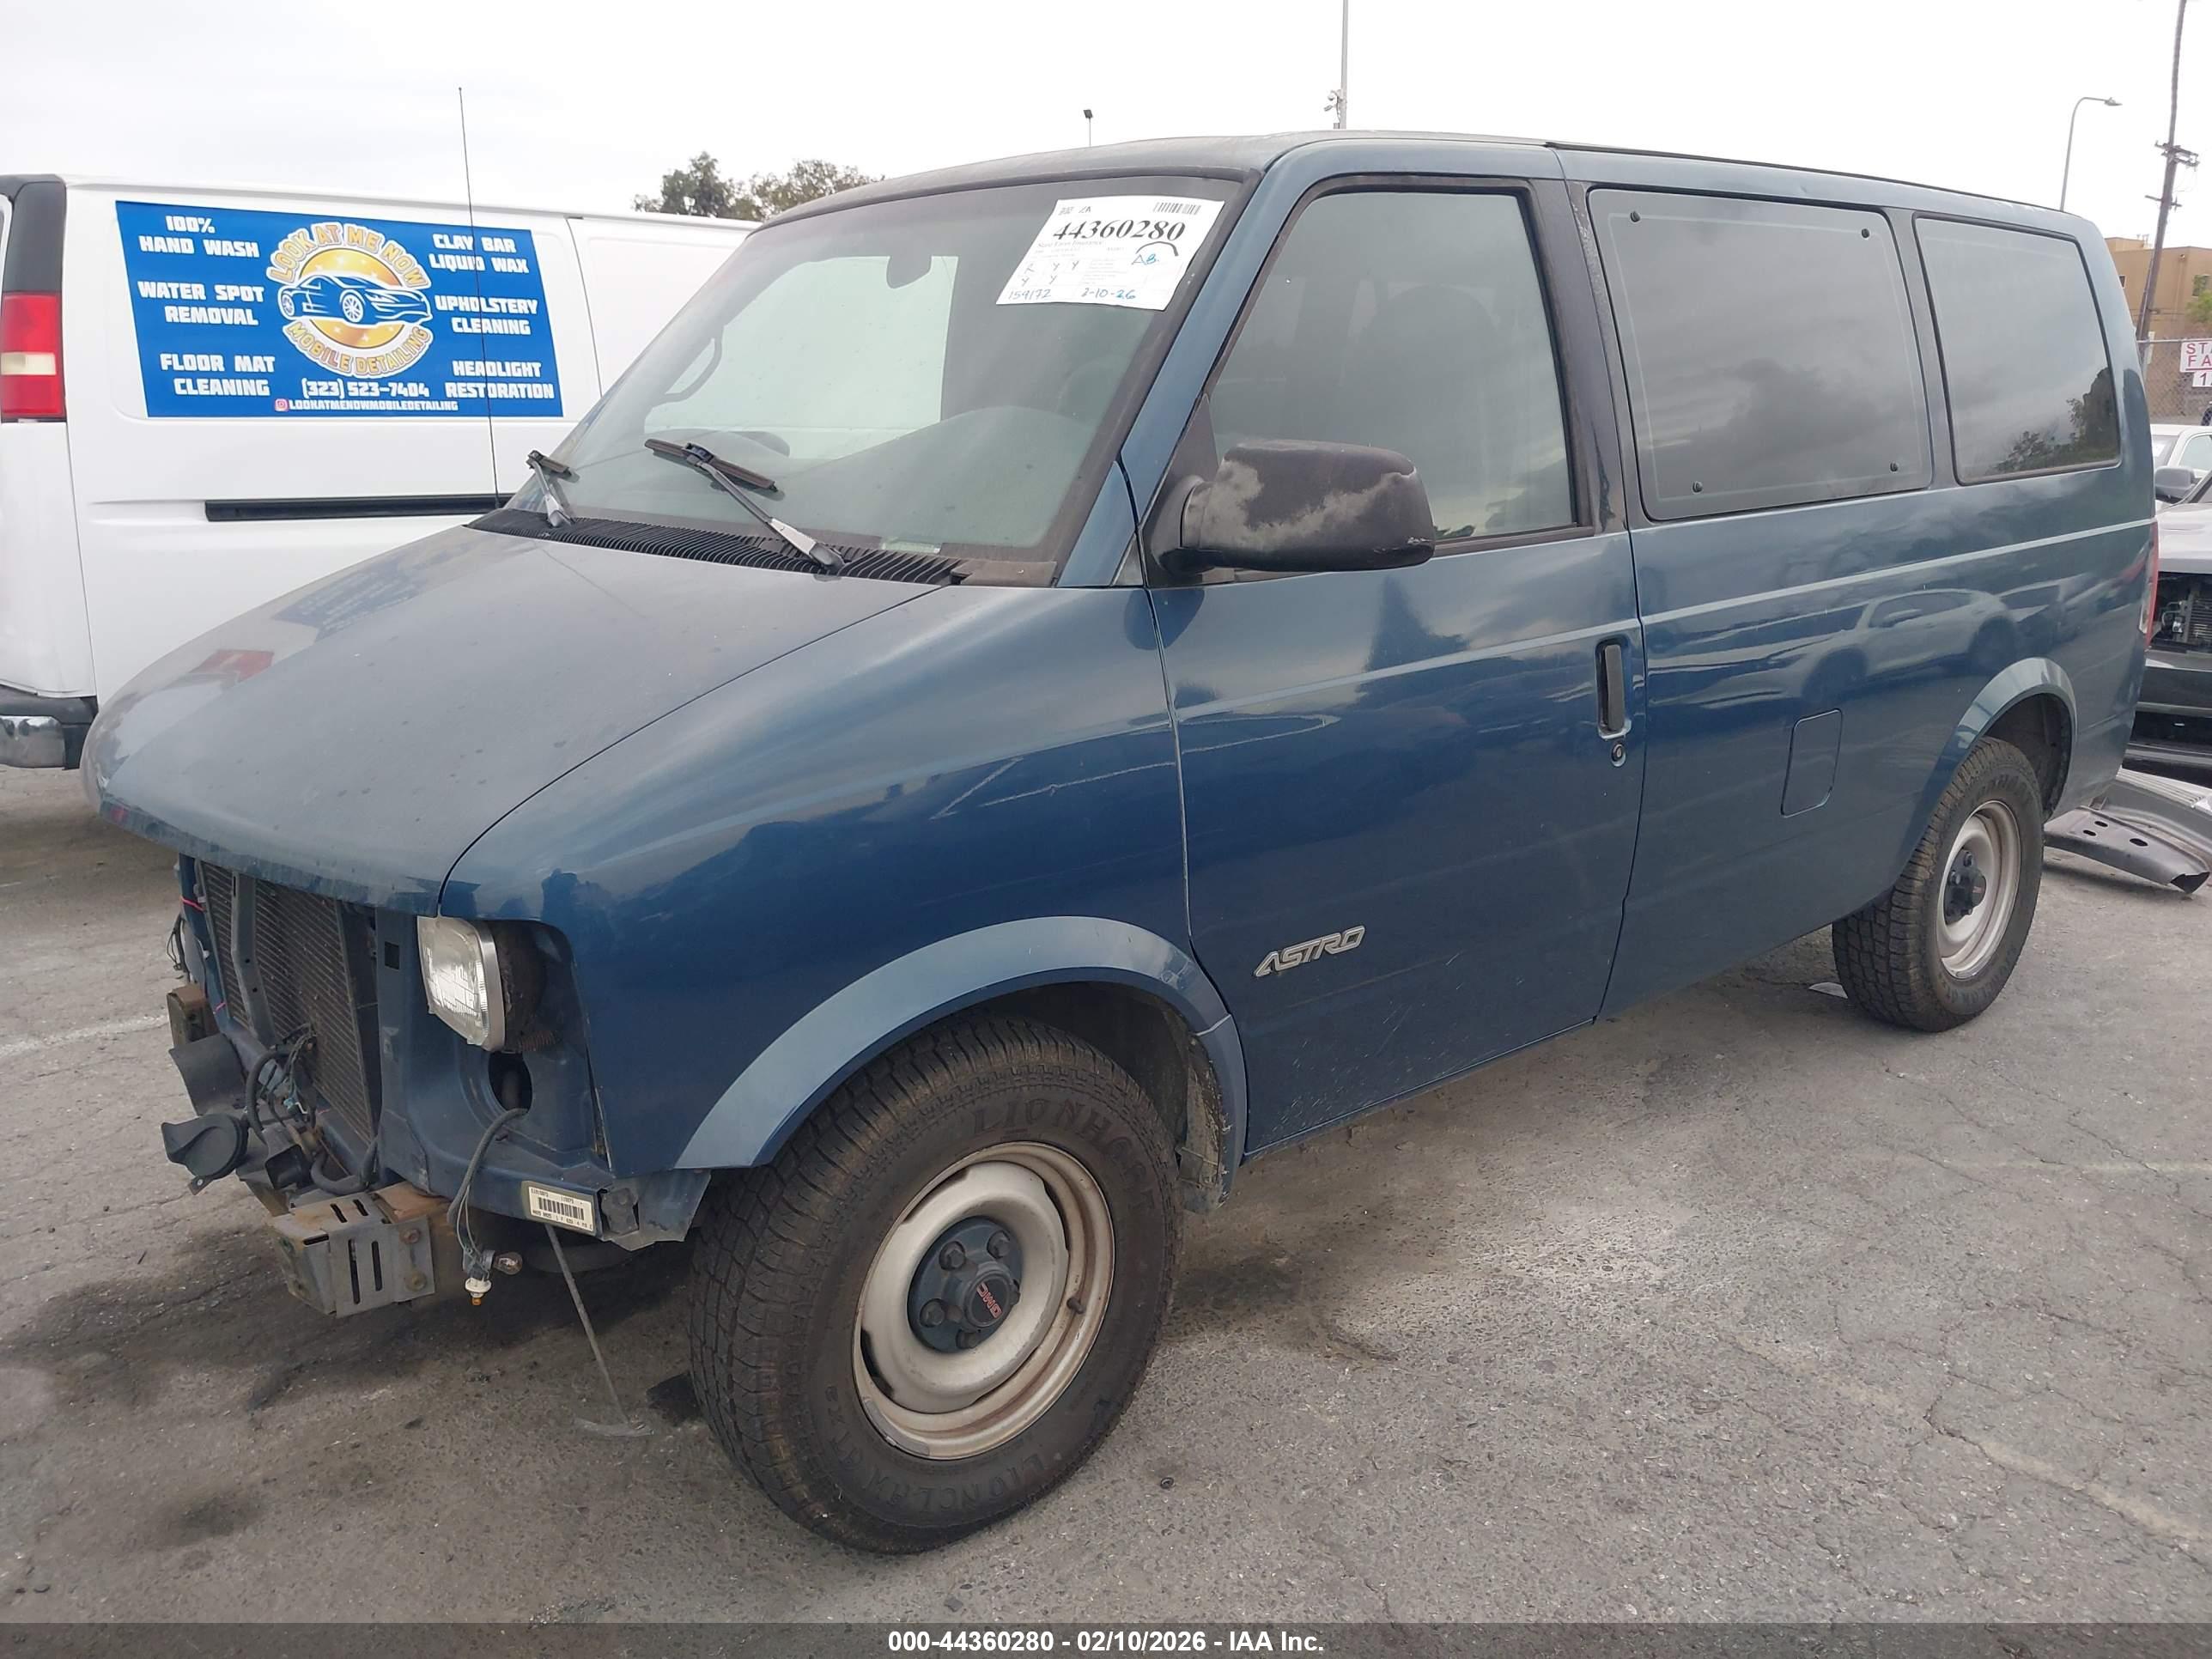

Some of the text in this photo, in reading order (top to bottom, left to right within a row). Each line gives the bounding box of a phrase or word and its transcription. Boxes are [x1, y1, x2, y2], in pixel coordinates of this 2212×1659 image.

[166, 216, 216, 234] 100%
[1053, 220, 1186, 241] 44360280
[138, 235, 259, 258] HAND WASH
[433, 234, 516, 252] CLAY BAR
[270, 224, 428, 288] LOOK AT ME NOW
[428, 253, 529, 273] LIQUID WAX
[137, 281, 264, 302] WATER SPOT
[434, 295, 538, 314] UPHOLSTERY
[165, 306, 258, 325] REMOVAL
[451, 317, 531, 335] CLEANING
[286, 321, 431, 375] MOBILE DETAILING
[2186, 343, 2212, 355] ST
[160, 353, 276, 373] FLOOR MAT
[453, 360, 541, 378] HEADLIGHT
[173, 378, 270, 396] CLEANING
[301, 377, 430, 399] (323) 523-7404
[2200, 373, 2212, 386] 1
[445, 382, 555, 399] RESTORATION
[1254, 925, 1365, 977] ASTRO
[976, 1281, 1003, 1319] GMC
